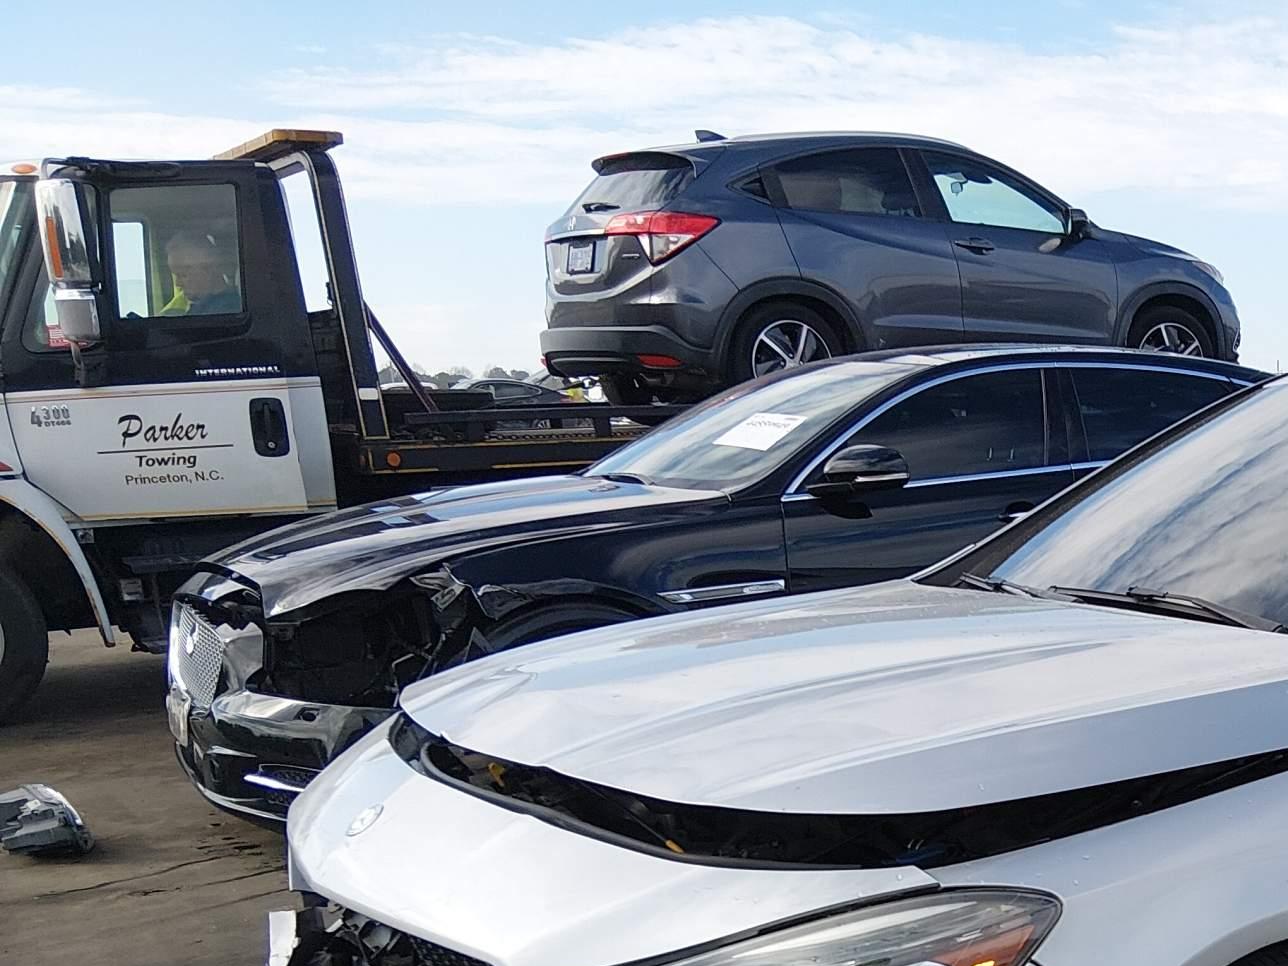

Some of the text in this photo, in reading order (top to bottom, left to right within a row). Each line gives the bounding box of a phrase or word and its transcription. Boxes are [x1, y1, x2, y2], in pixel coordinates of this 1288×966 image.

[195, 365, 281, 377] INTERNATIONAL
[31, 404, 71, 428] 4300
[117, 412, 208, 448] Parker
[135, 452, 197, 468] Towing
[125, 470, 225, 485] Princeton, N.C.
